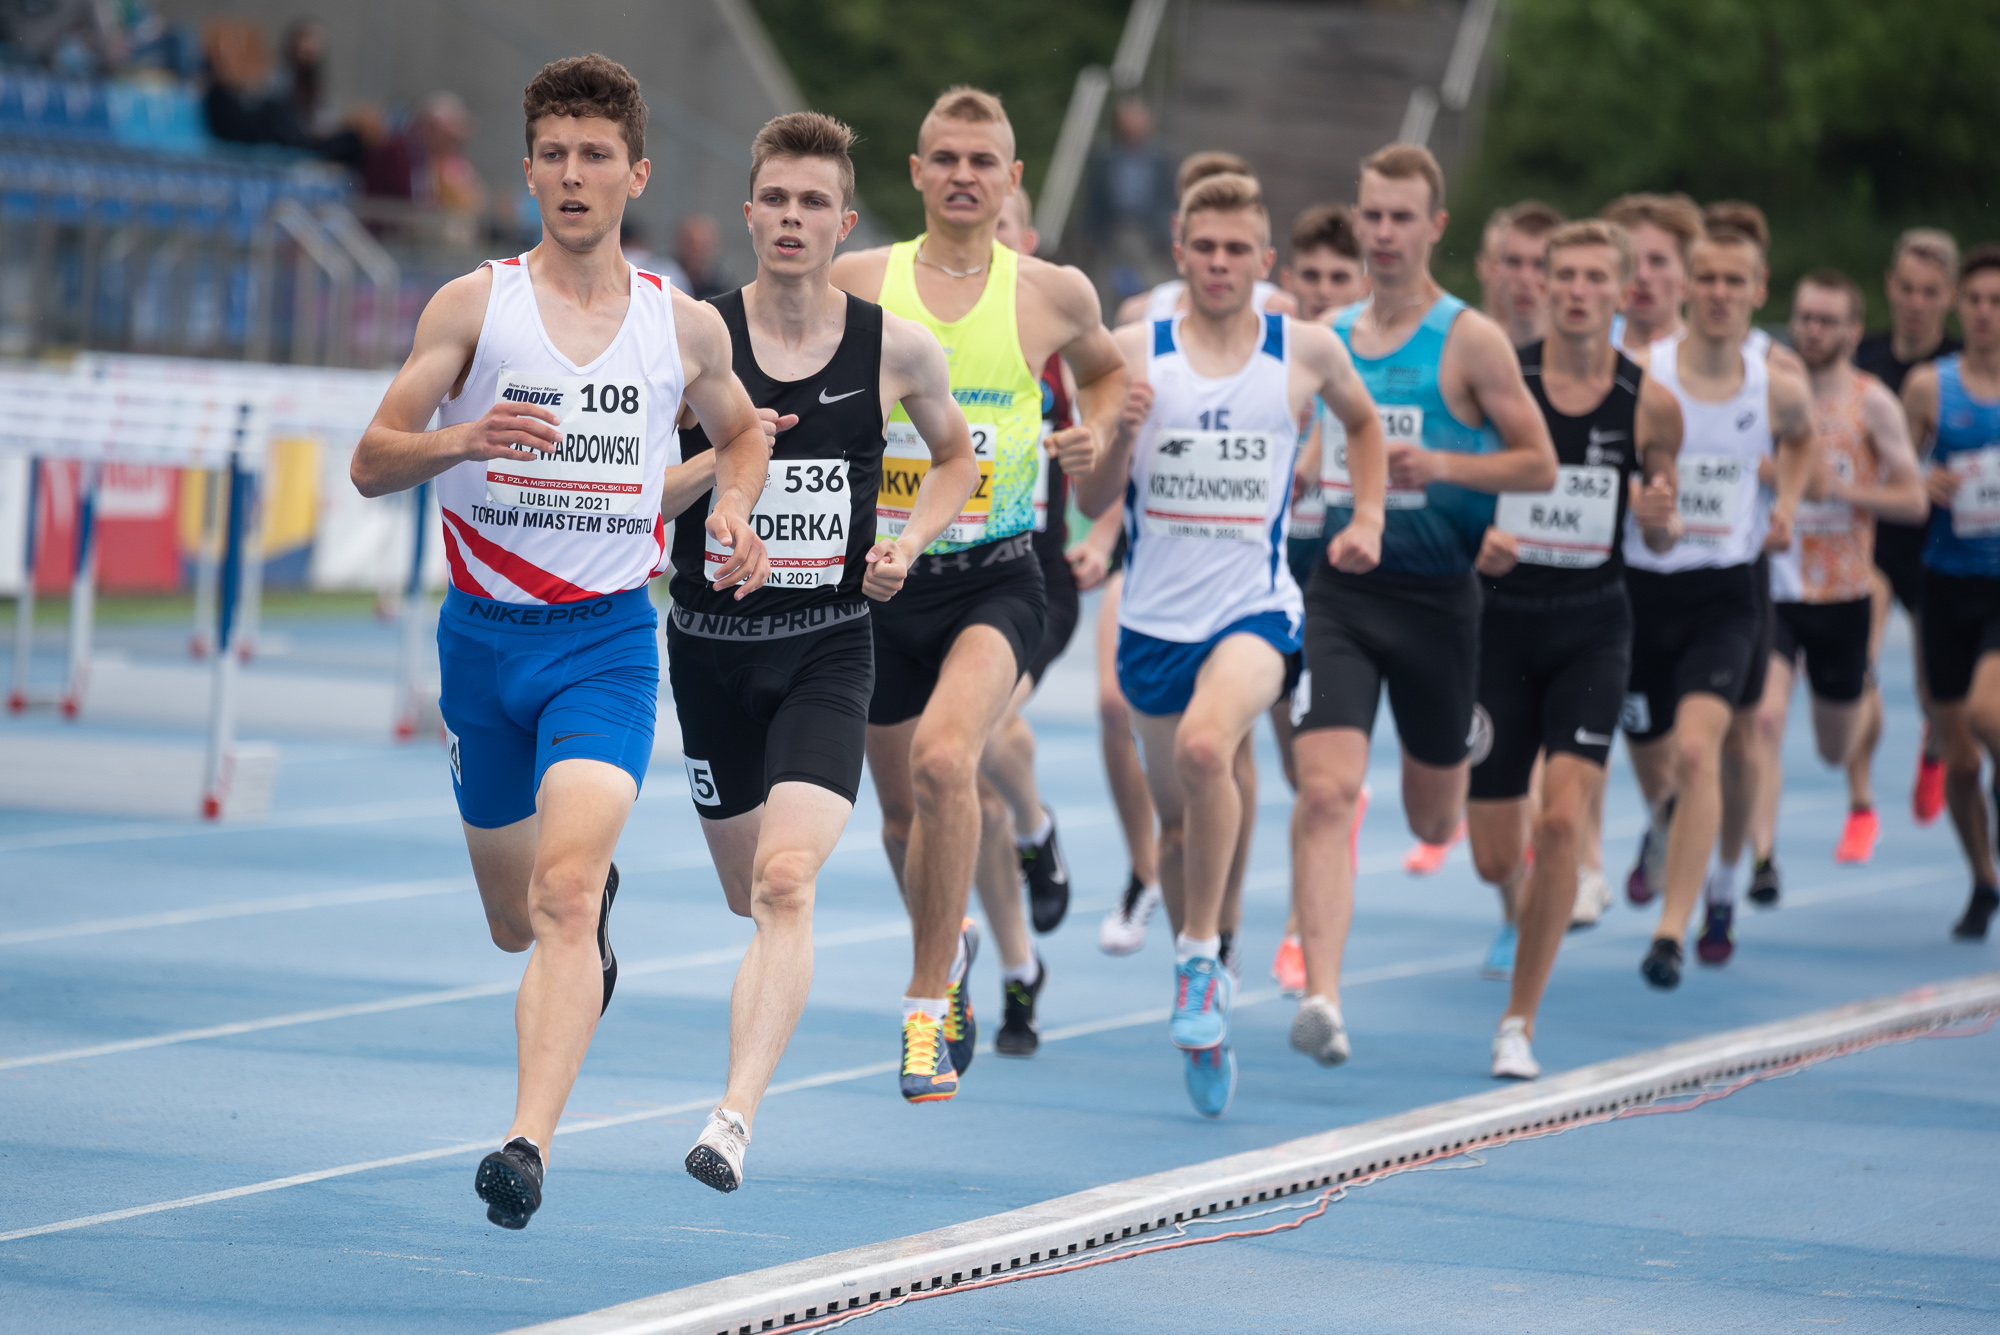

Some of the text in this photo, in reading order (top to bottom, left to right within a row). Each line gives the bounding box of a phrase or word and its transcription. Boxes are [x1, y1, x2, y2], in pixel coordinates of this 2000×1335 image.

[580, 384, 639, 414] 108
[1217, 438, 1266, 460] 153
[494, 474, 506, 482] 75.
[507, 477, 529, 485] PZLA
[530, 480, 590, 490] MISTRZOSTWA
[592, 484, 621, 492] POLSKI
[784, 465, 844, 493] 536
[1565, 475, 1612, 498] 362
[519, 492, 610, 511] LUBLIN 2021
[471, 504, 652, 535] TORUŃ MIASTEM SPORTU
[1529, 503, 1583, 532] RAK
[786, 572, 819, 585] 2021
[468, 600, 613, 626] NIKE PRO
[698, 614, 764, 637] NIKE
[768, 606, 826, 635] PRO
